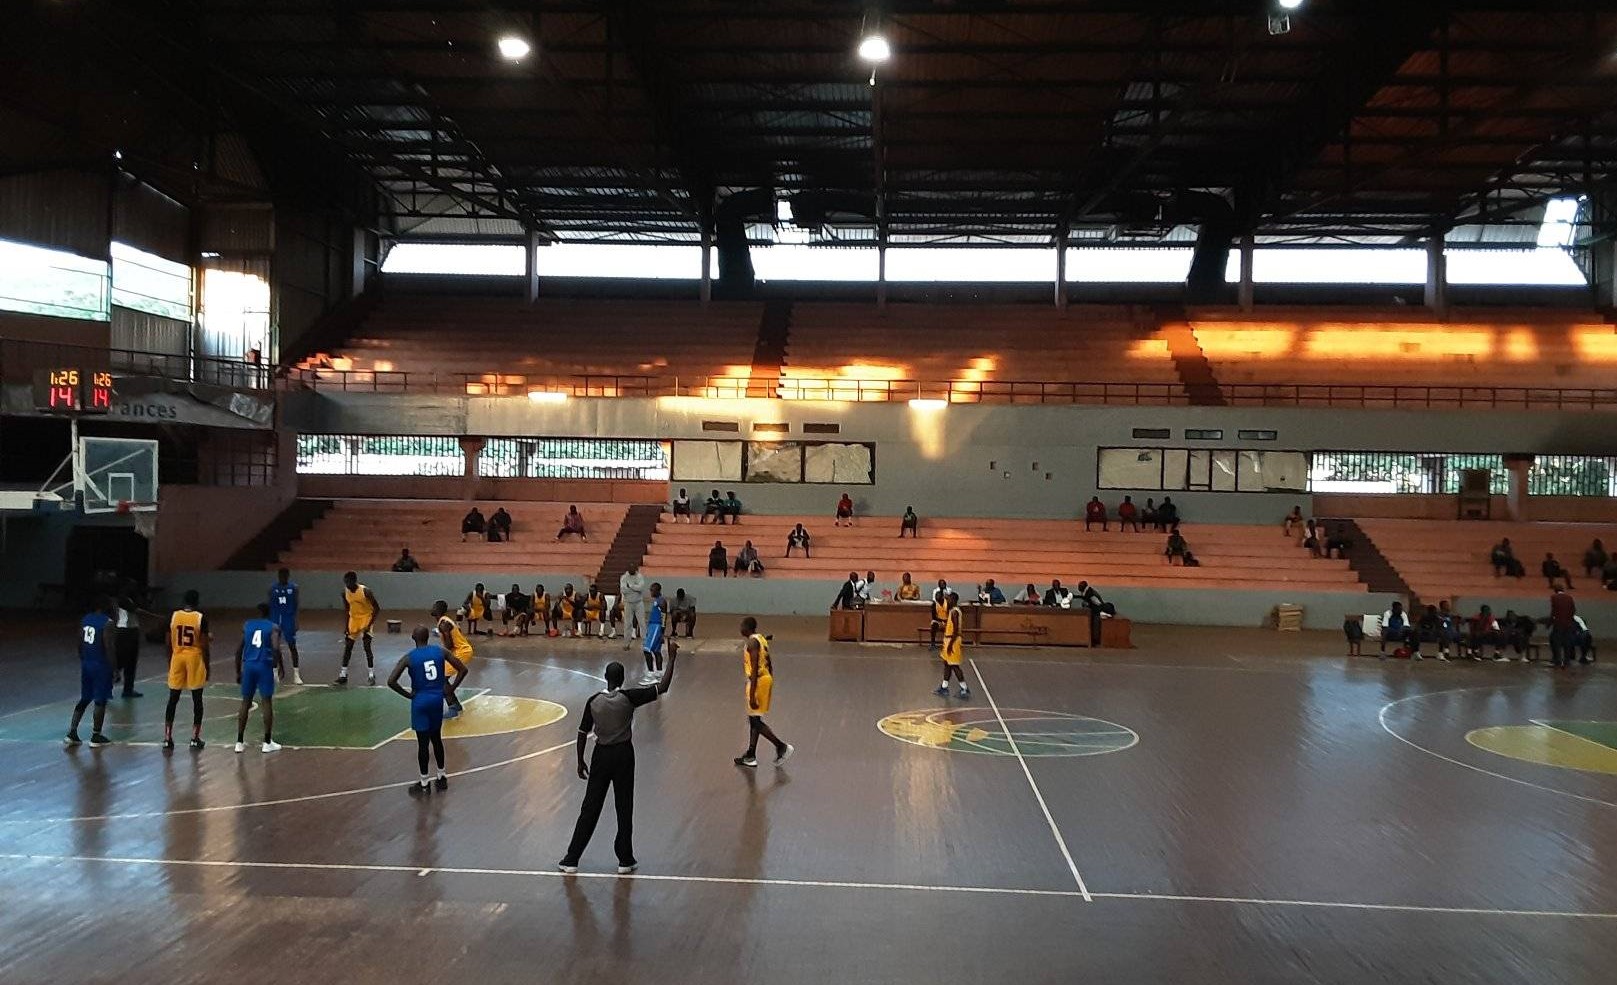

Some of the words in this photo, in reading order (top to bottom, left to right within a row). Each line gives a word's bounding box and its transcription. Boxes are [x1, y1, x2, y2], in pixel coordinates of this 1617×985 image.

[50, 370, 78, 385] 1:26
[50, 387, 72, 407] 14
[93, 388, 109, 407] 14
[176, 625, 194, 646] 15
[251, 629, 263, 648] 4
[423, 659, 438, 681] 5
